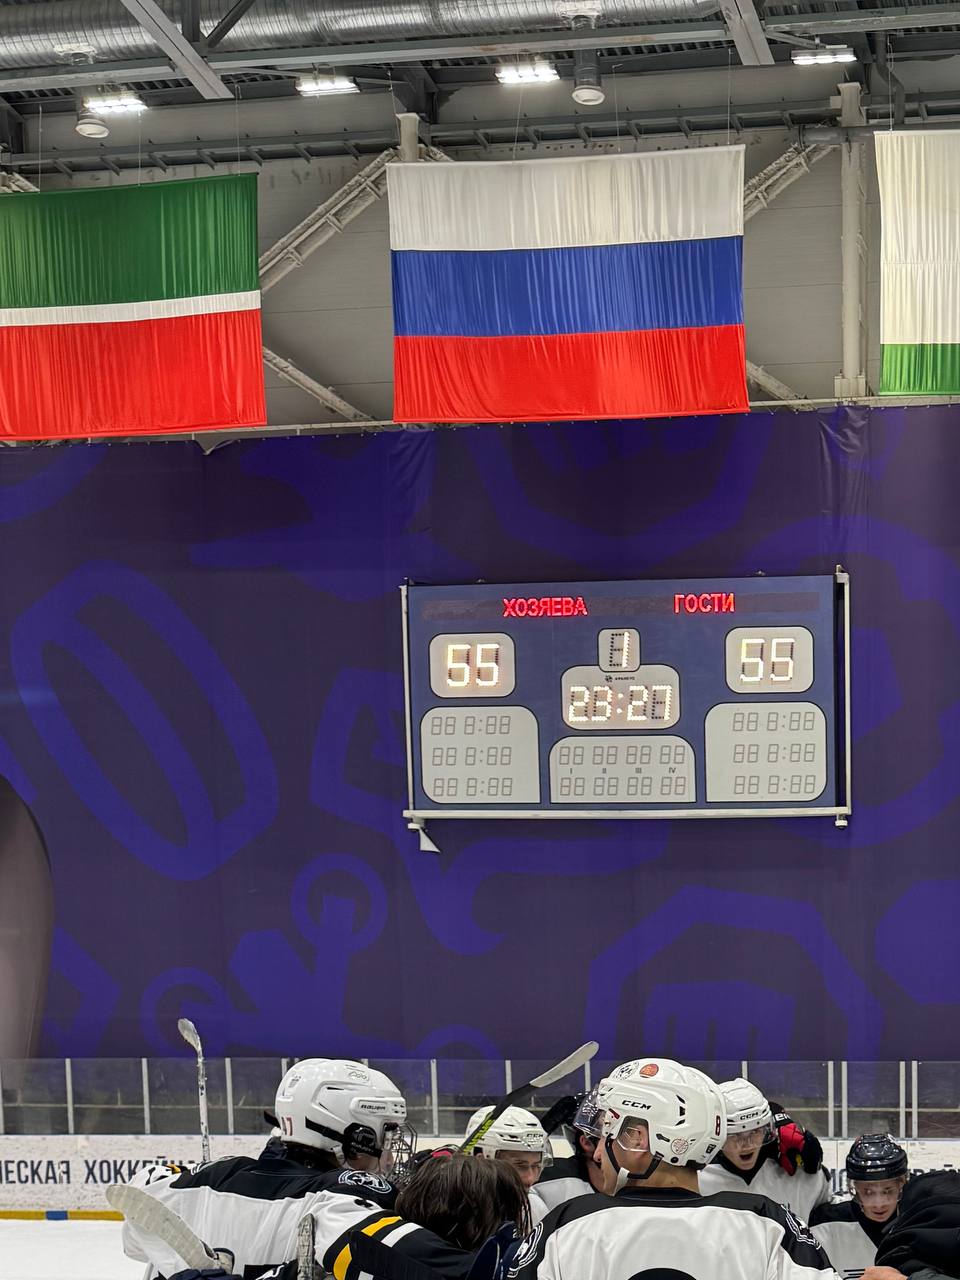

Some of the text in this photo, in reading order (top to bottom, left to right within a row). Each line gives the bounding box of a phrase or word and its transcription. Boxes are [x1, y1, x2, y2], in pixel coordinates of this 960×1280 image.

[502, 597, 588, 617] ХОЗЯЕВА
[673, 592, 736, 613] ГОСТИ
[446, 643, 500, 687] 55
[740, 638, 796, 682] 55
[568, 685, 673, 721] 23:27
[621, 1099, 652, 1111] CCM
[715, 1115, 721, 1137] 8
[739, 1112, 759, 1121] CCM
